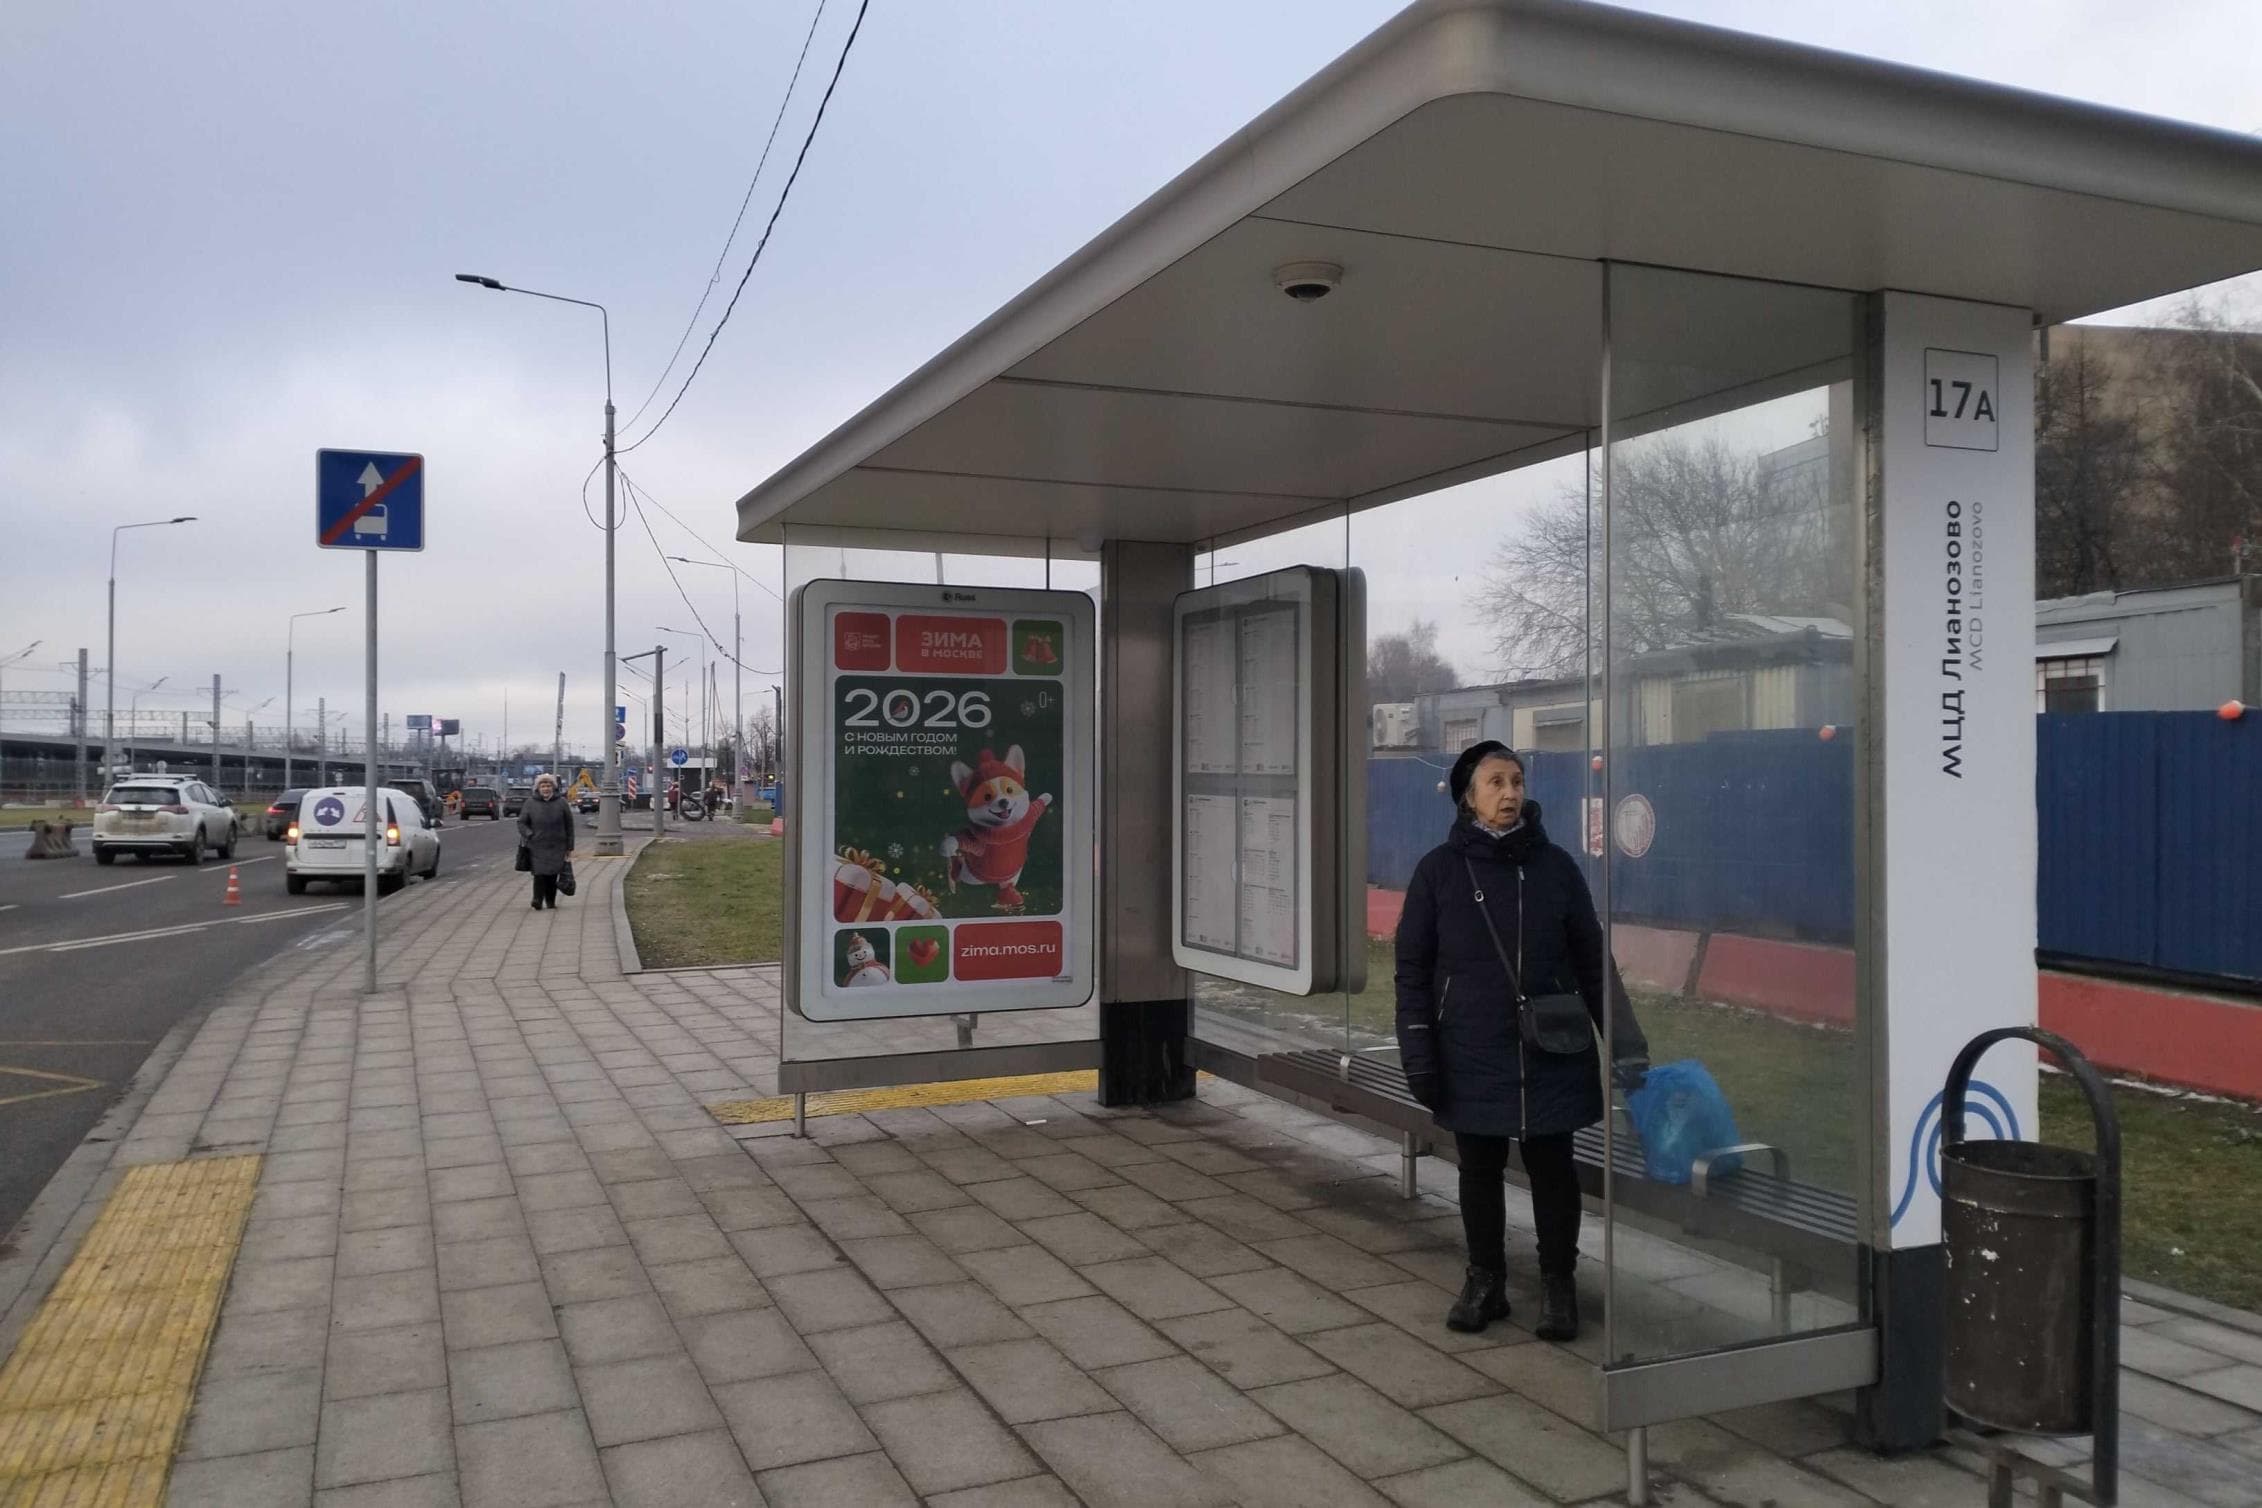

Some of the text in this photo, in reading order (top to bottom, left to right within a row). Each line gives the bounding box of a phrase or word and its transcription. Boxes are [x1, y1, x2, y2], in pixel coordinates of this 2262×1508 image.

[1969, 501, 1984, 671] MCD Lianozovo
[920, 631, 983, 648] ЗИМА
[1942, 500, 1966, 779] МЦД Лианозово
[844, 688, 992, 728] 2026
[844, 732, 957, 744] С НОВЫМ ГОДОМ
[844, 745, 957, 756] И РОЖДЕСТВОМ!
[960, 944, 1056, 957] zima.mos.ru
